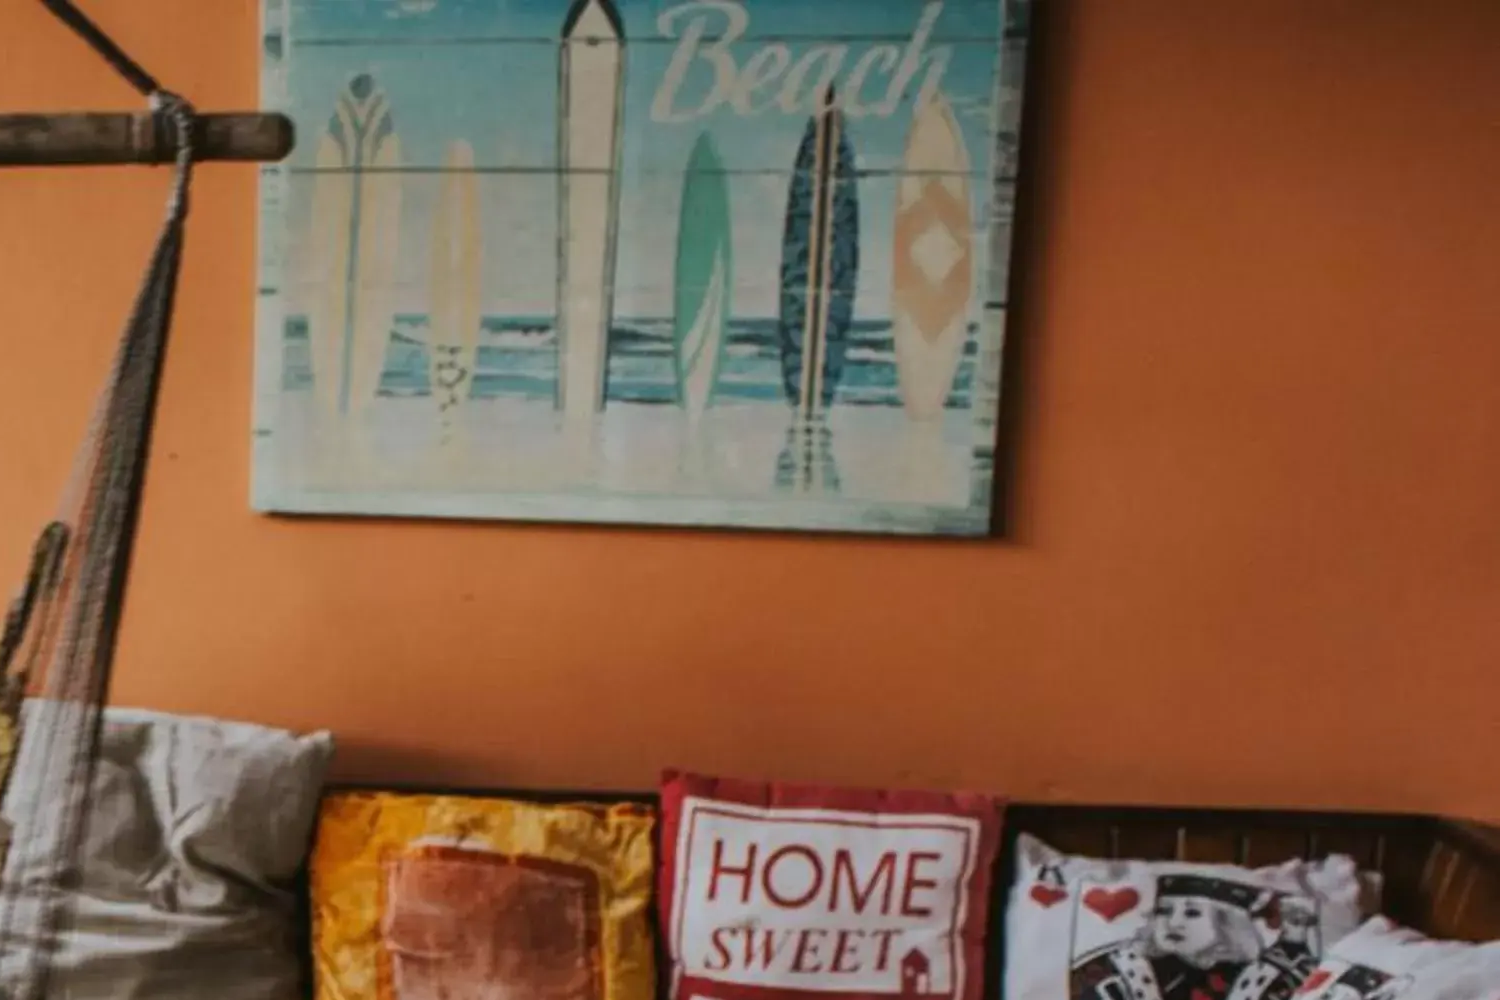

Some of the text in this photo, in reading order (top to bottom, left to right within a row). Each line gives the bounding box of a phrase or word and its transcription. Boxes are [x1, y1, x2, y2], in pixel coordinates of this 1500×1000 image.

[650, 0, 953, 123] Beach
[707, 839, 942, 917] HOME
[703, 922, 905, 973] SWEET
